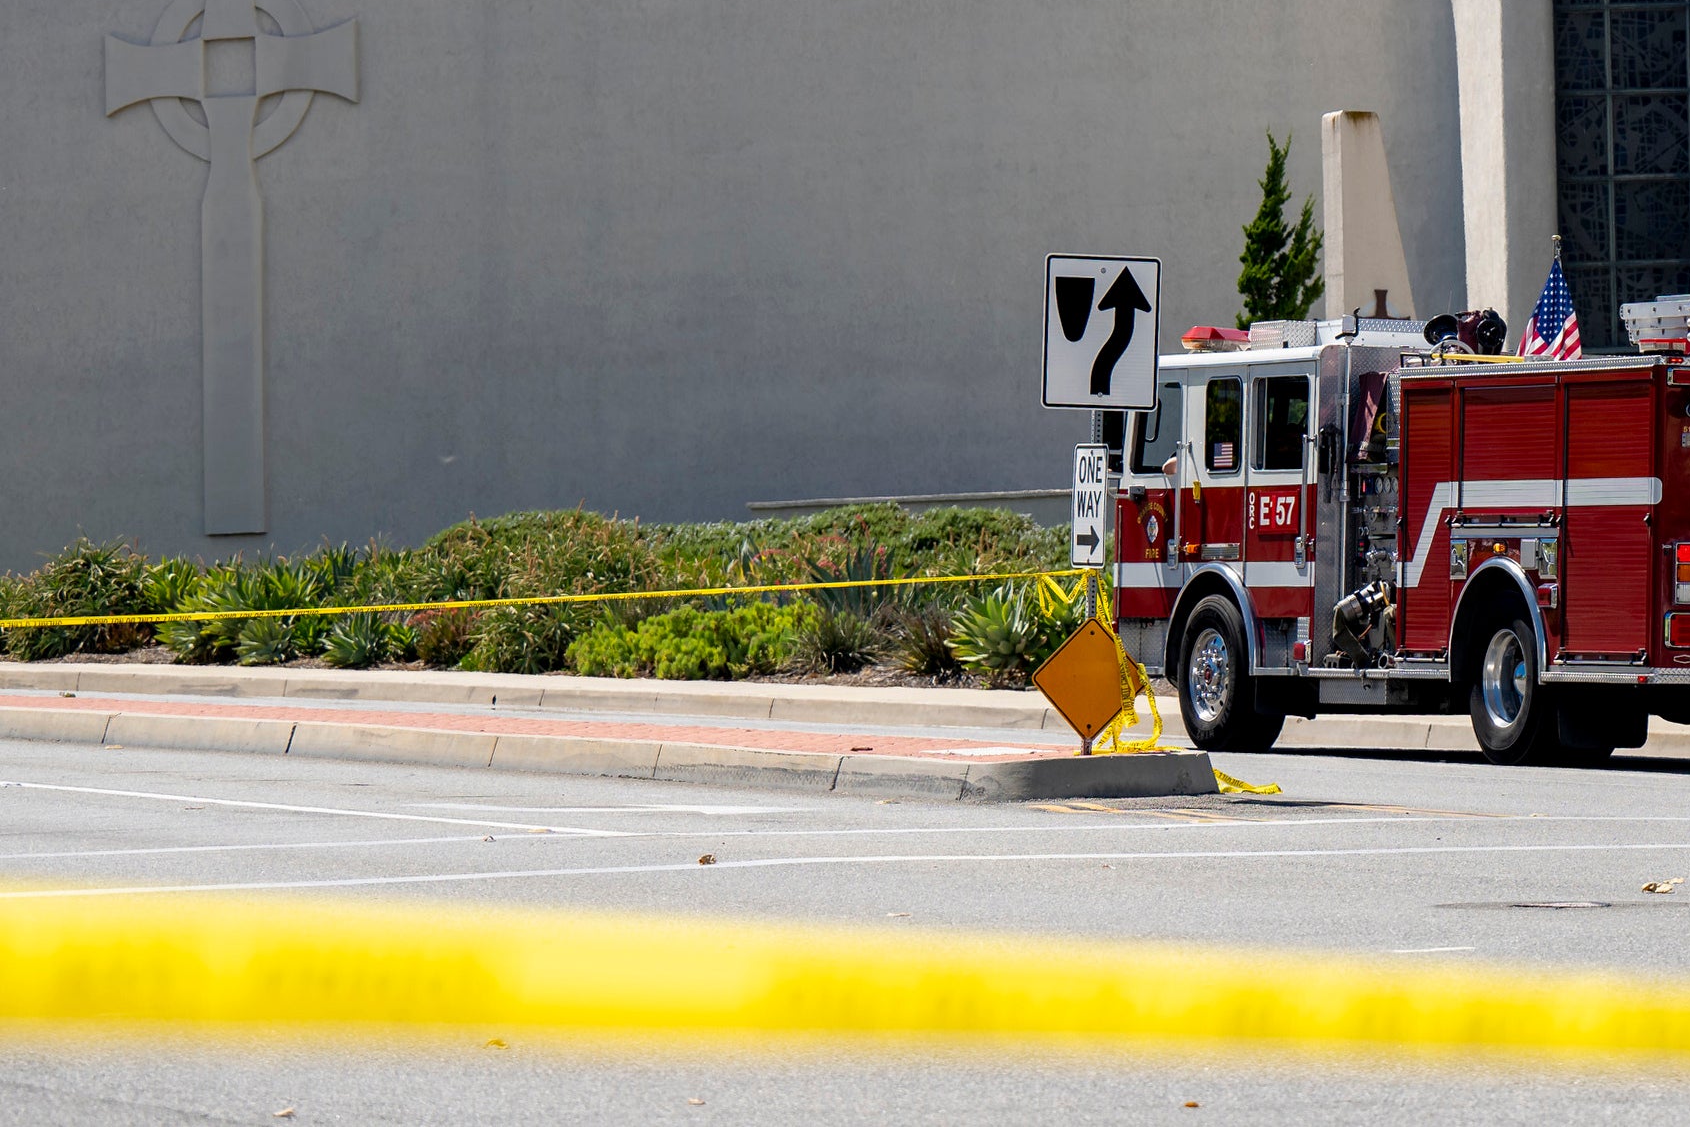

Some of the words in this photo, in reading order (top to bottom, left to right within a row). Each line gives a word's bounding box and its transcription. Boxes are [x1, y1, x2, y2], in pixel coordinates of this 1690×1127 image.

[1079, 455, 1103, 484] ONE
[1077, 490, 1102, 518] WAY
[1145, 548, 1159, 559] FIRE
